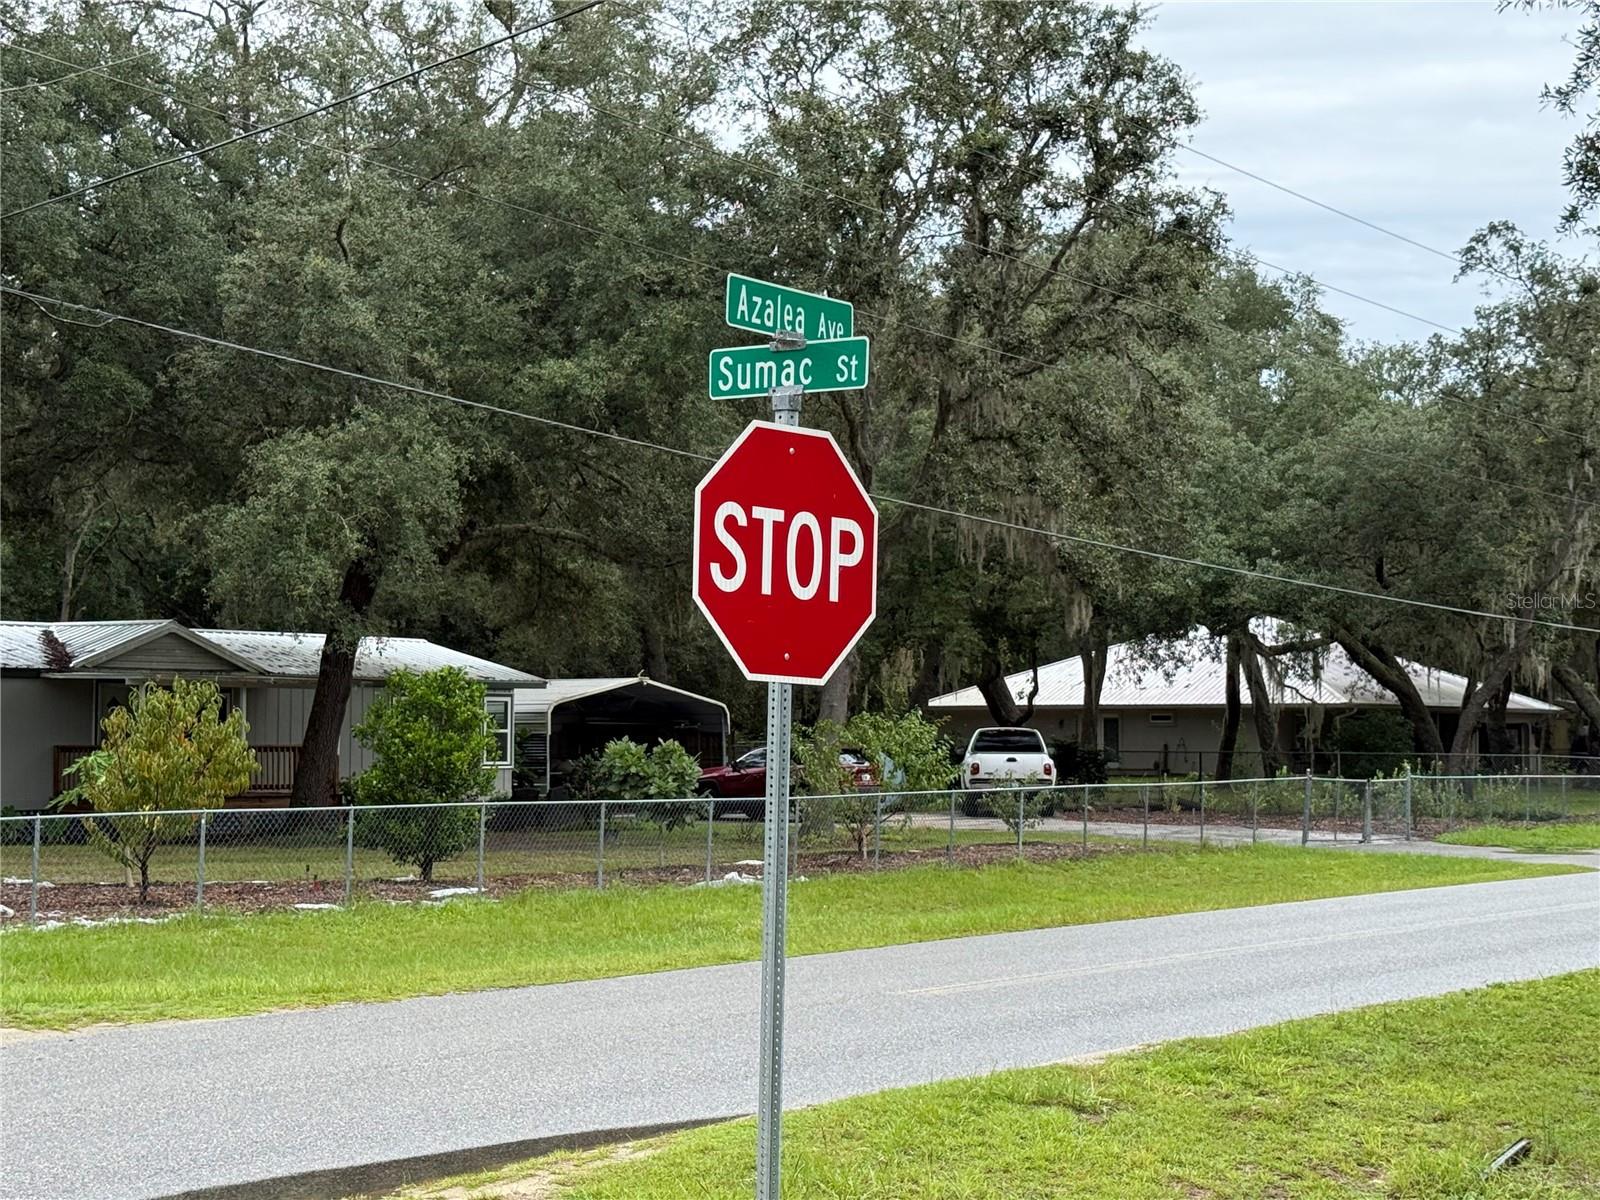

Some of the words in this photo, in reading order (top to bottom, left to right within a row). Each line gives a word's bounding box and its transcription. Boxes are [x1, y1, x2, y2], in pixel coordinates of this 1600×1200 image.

[736, 284, 805, 333] Azalea
[817, 312, 844, 339] Ave
[718, 356, 813, 391] Sumac
[836, 354, 859, 383] St
[709, 501, 865, 603] STOP
